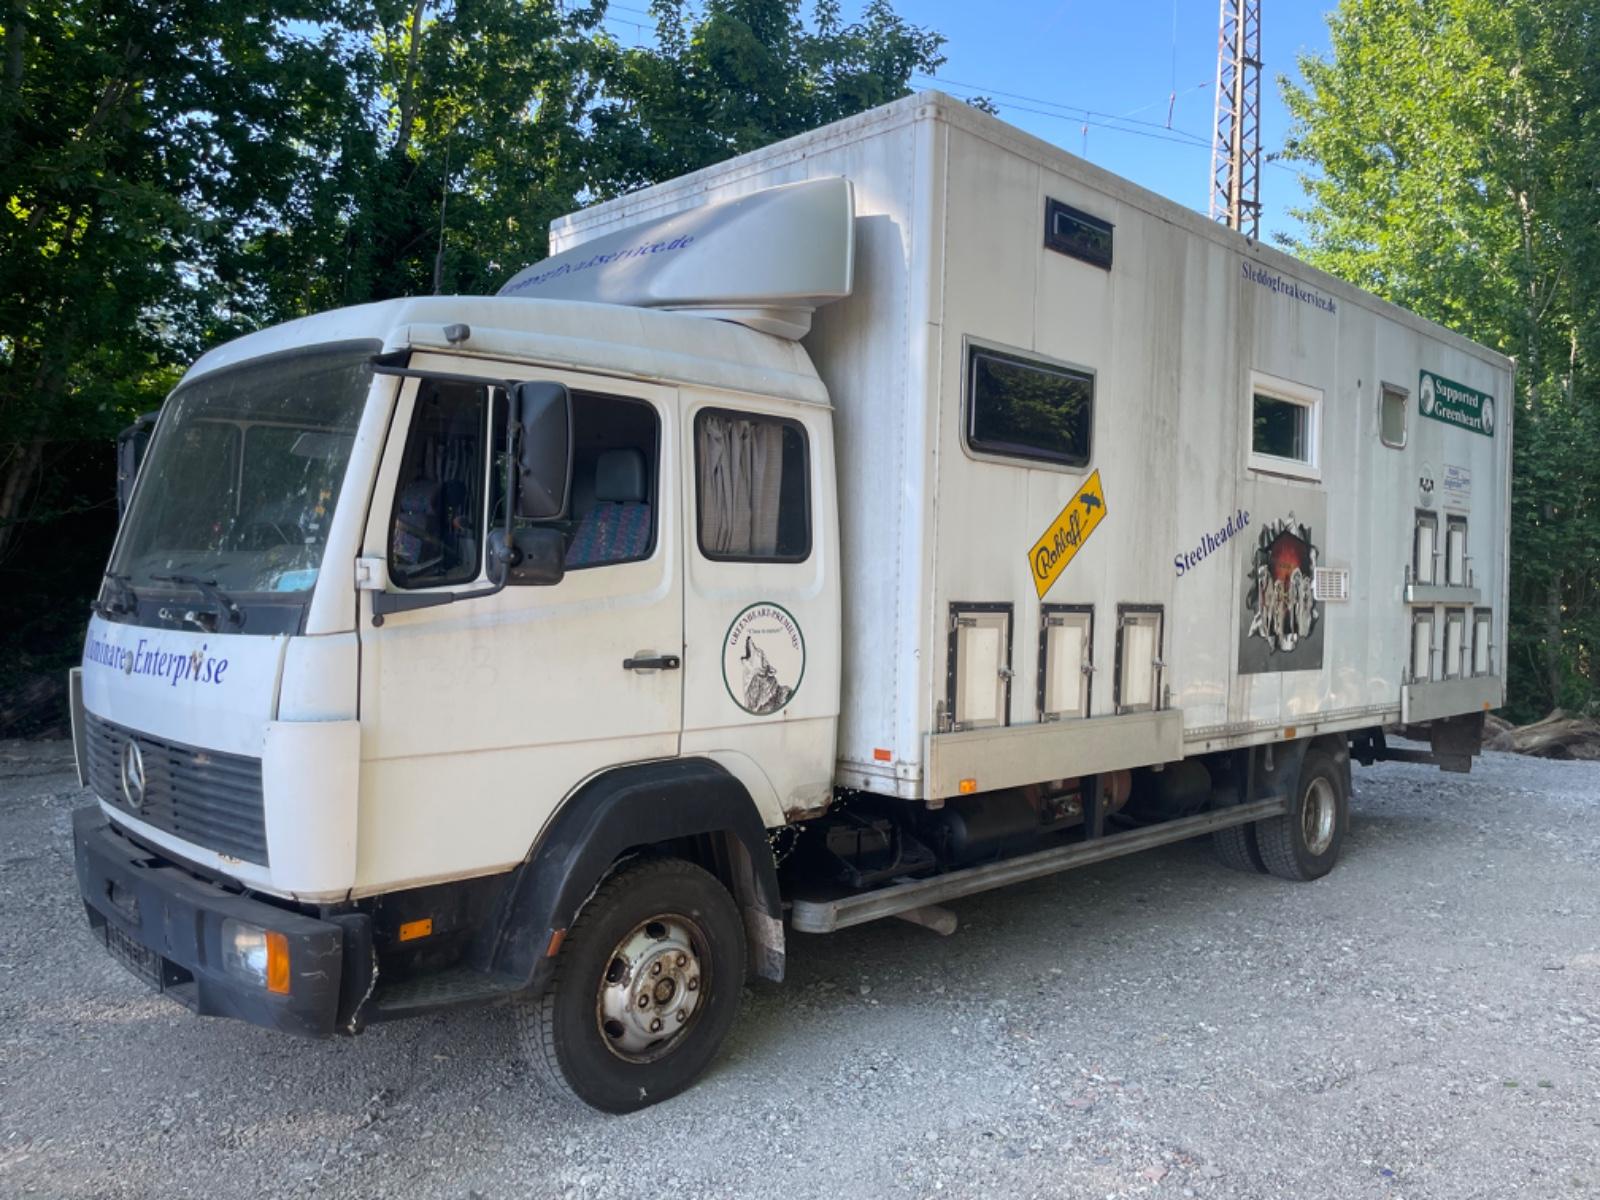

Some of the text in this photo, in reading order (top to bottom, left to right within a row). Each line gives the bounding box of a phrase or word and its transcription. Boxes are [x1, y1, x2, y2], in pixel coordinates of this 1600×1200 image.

[1434, 401, 1481, 429] Greenheart
[1435, 379, 1479, 408] Supported
[1036, 509, 1088, 580] Rohloff
[1174, 508, 1251, 577] Steelhead.de
[133, 639, 229, 687] Enterprise
